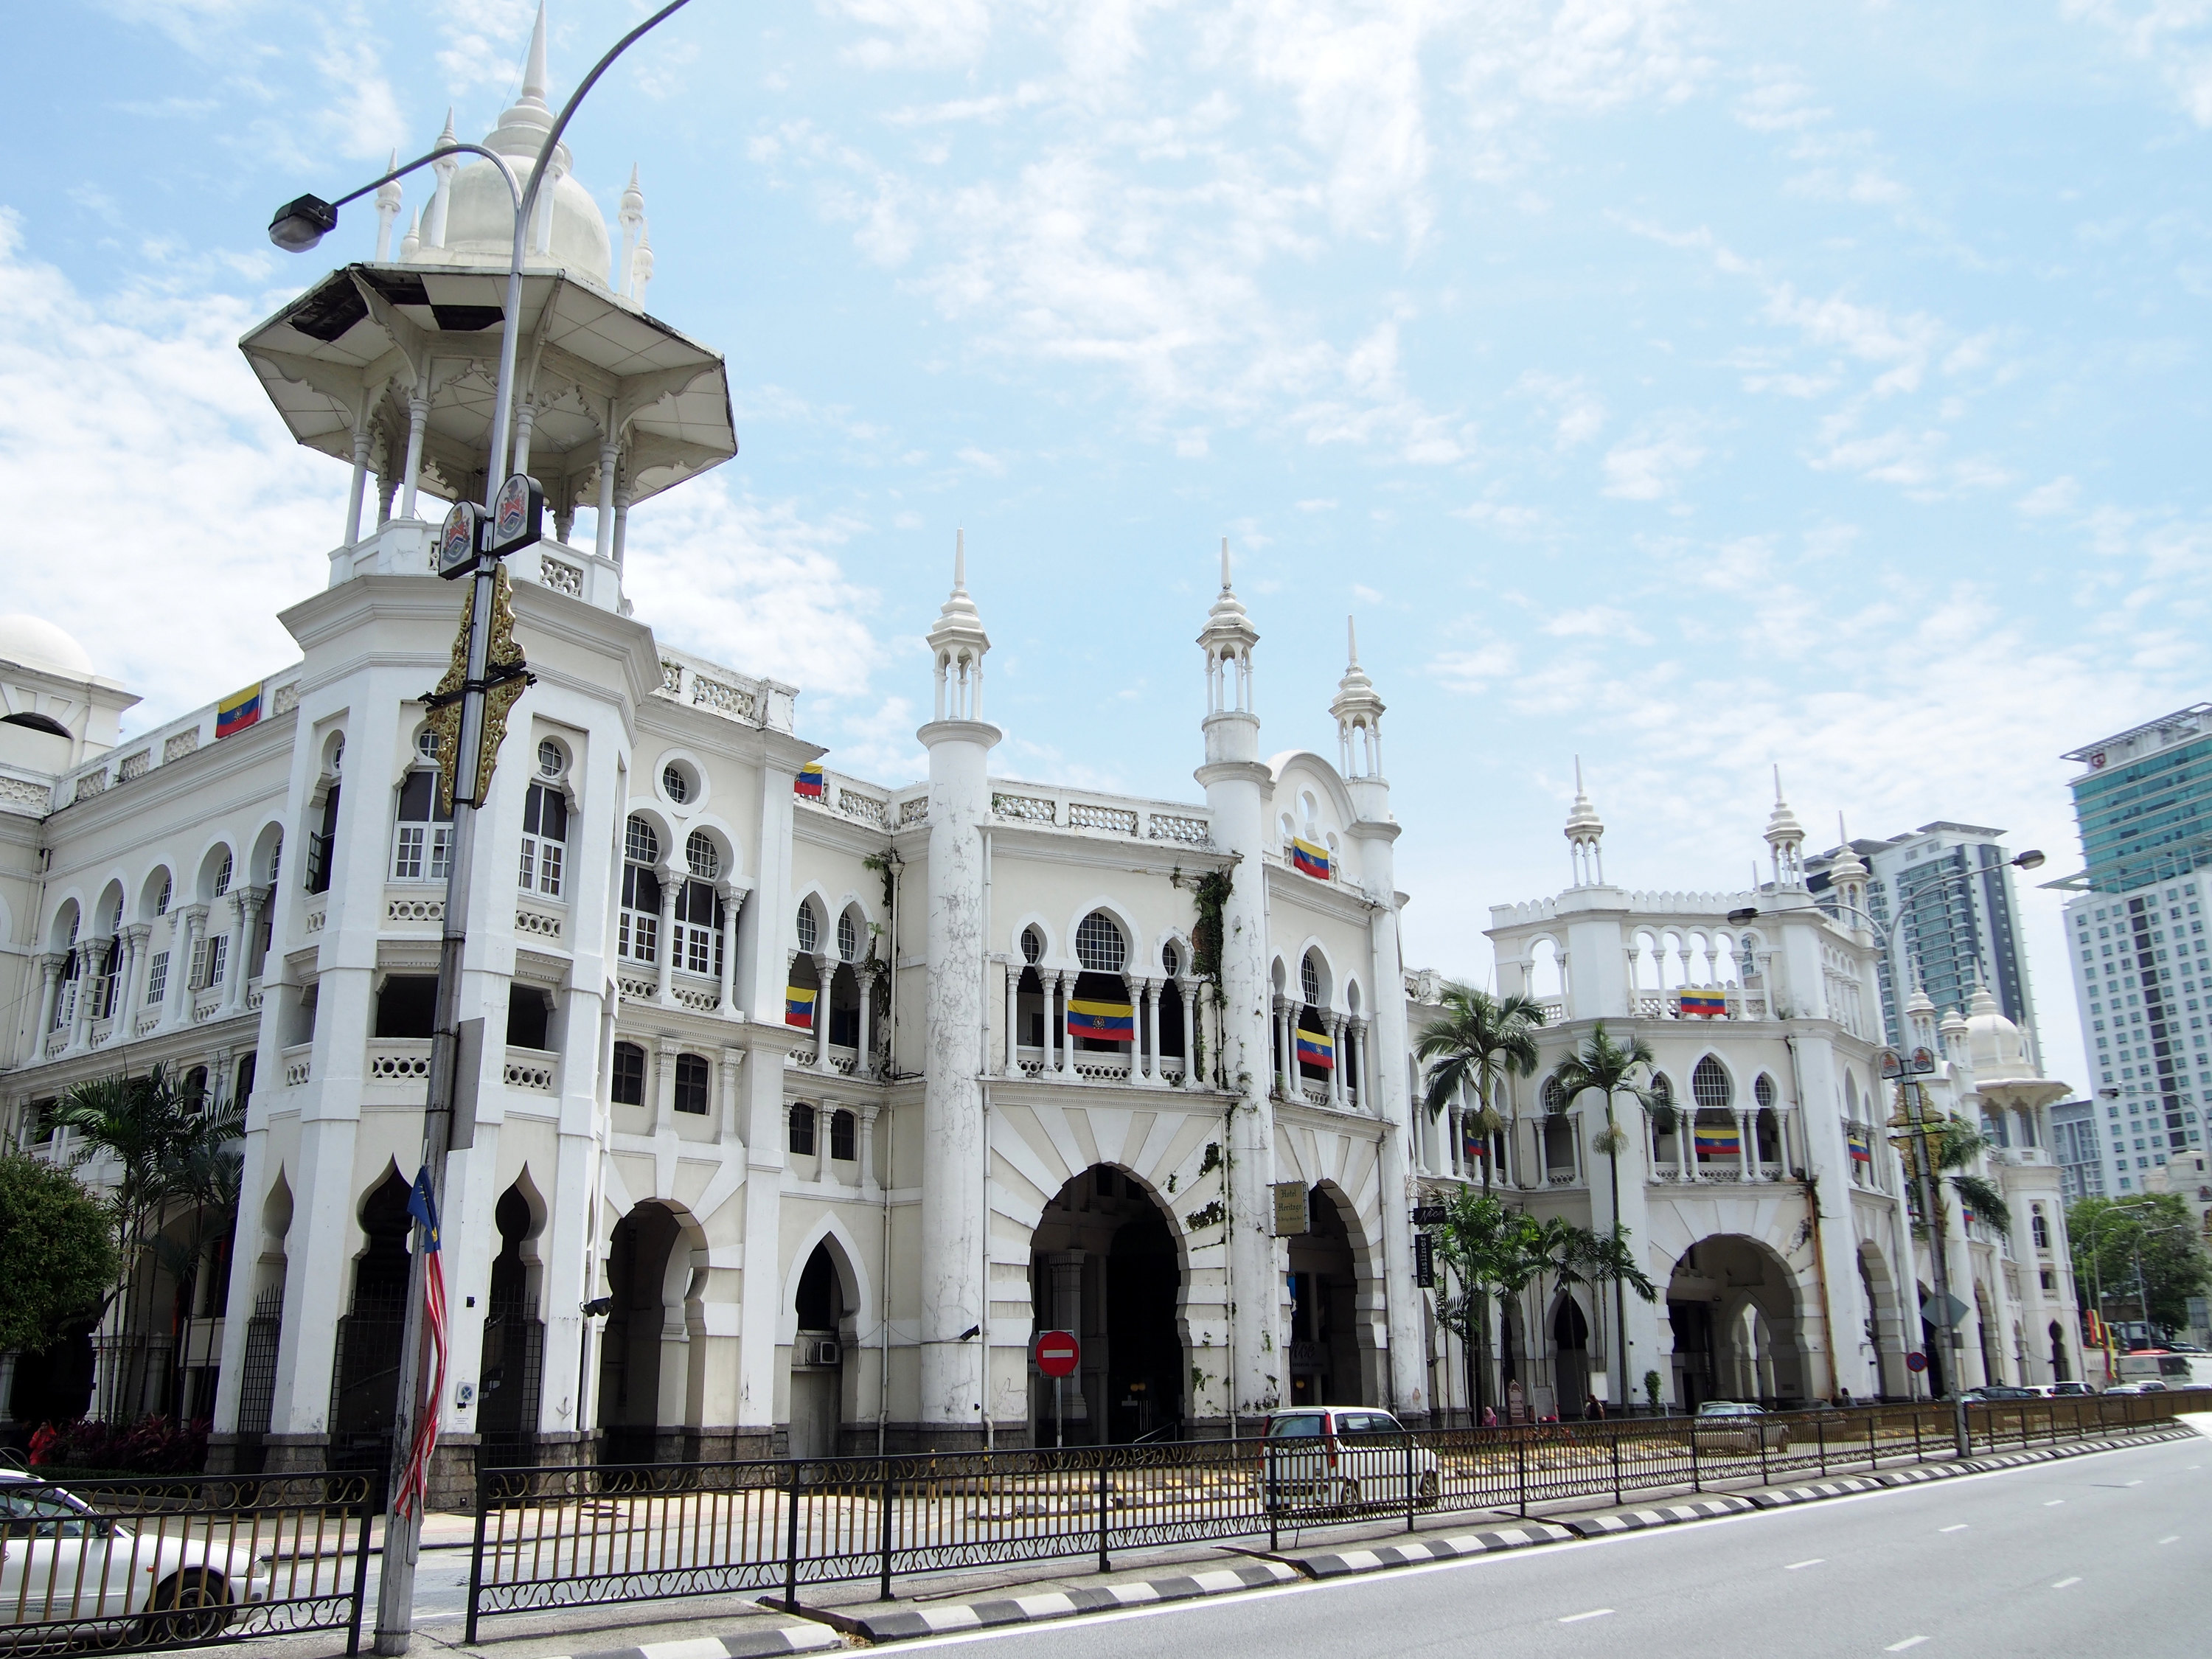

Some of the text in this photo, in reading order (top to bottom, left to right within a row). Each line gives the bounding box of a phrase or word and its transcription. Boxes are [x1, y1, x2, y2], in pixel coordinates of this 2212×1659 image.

[1280, 1188, 1297, 1198] Hotel
[1277, 1203, 1302, 1213] Heritage
[1419, 1208, 1443, 1222] Nice
[1420, 1236, 1429, 1285] Plusliner
